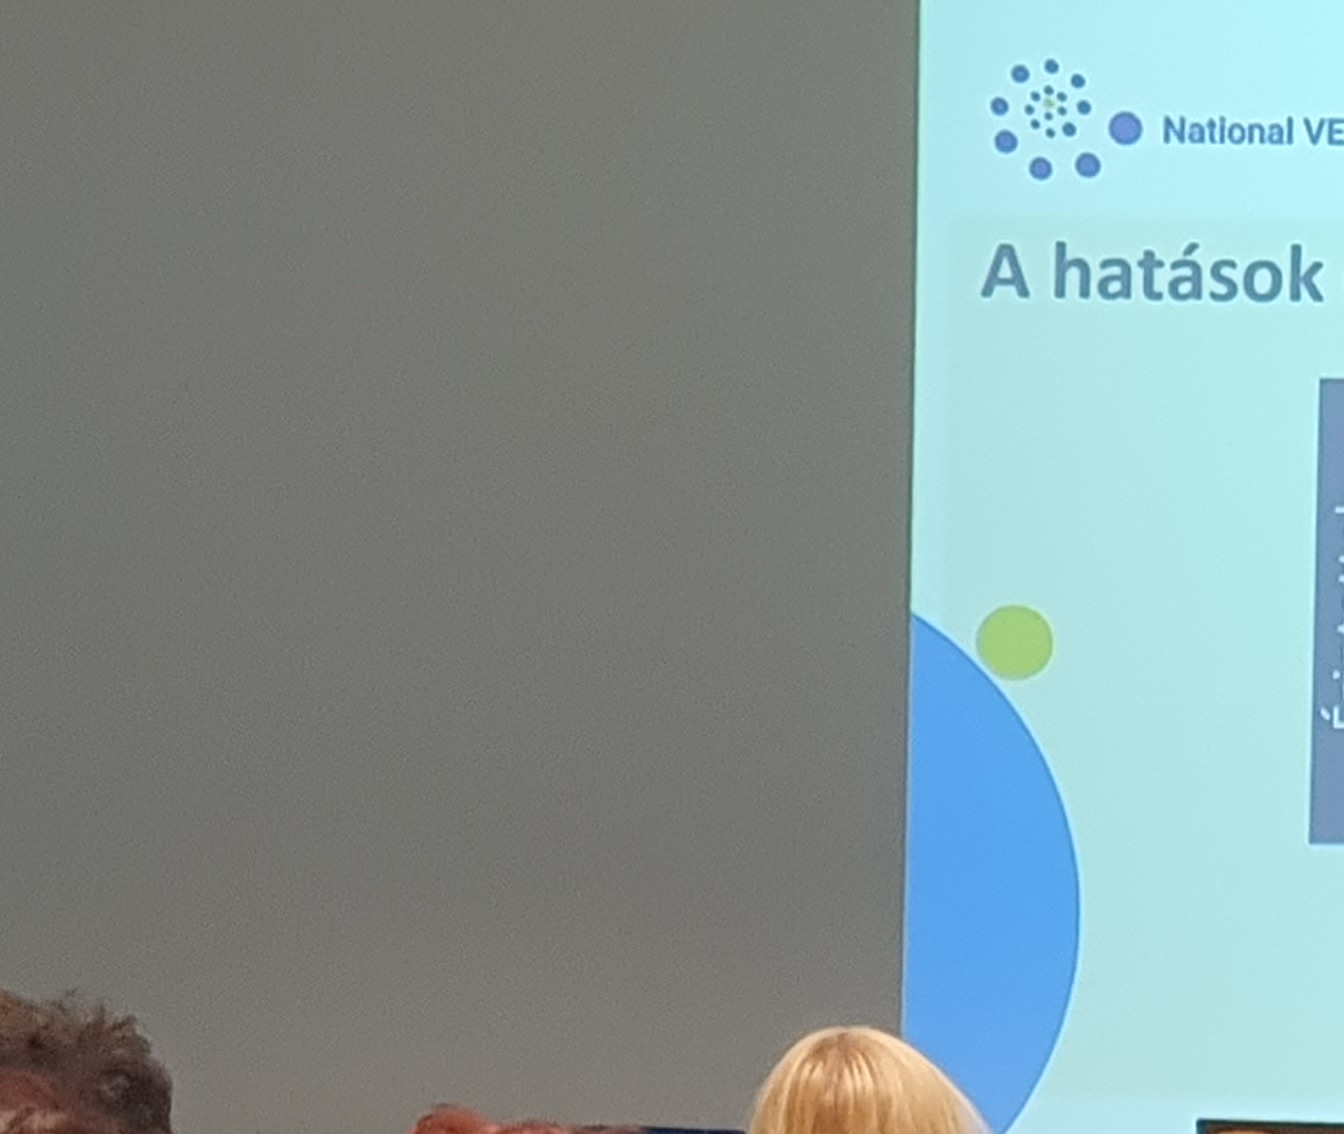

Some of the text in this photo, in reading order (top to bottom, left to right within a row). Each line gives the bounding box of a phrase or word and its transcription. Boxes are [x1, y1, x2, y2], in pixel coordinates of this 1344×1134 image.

[1162, 114, 1295, 146] National
[980, 243, 1031, 299] A
[1053, 241, 1324, 303] hatások
